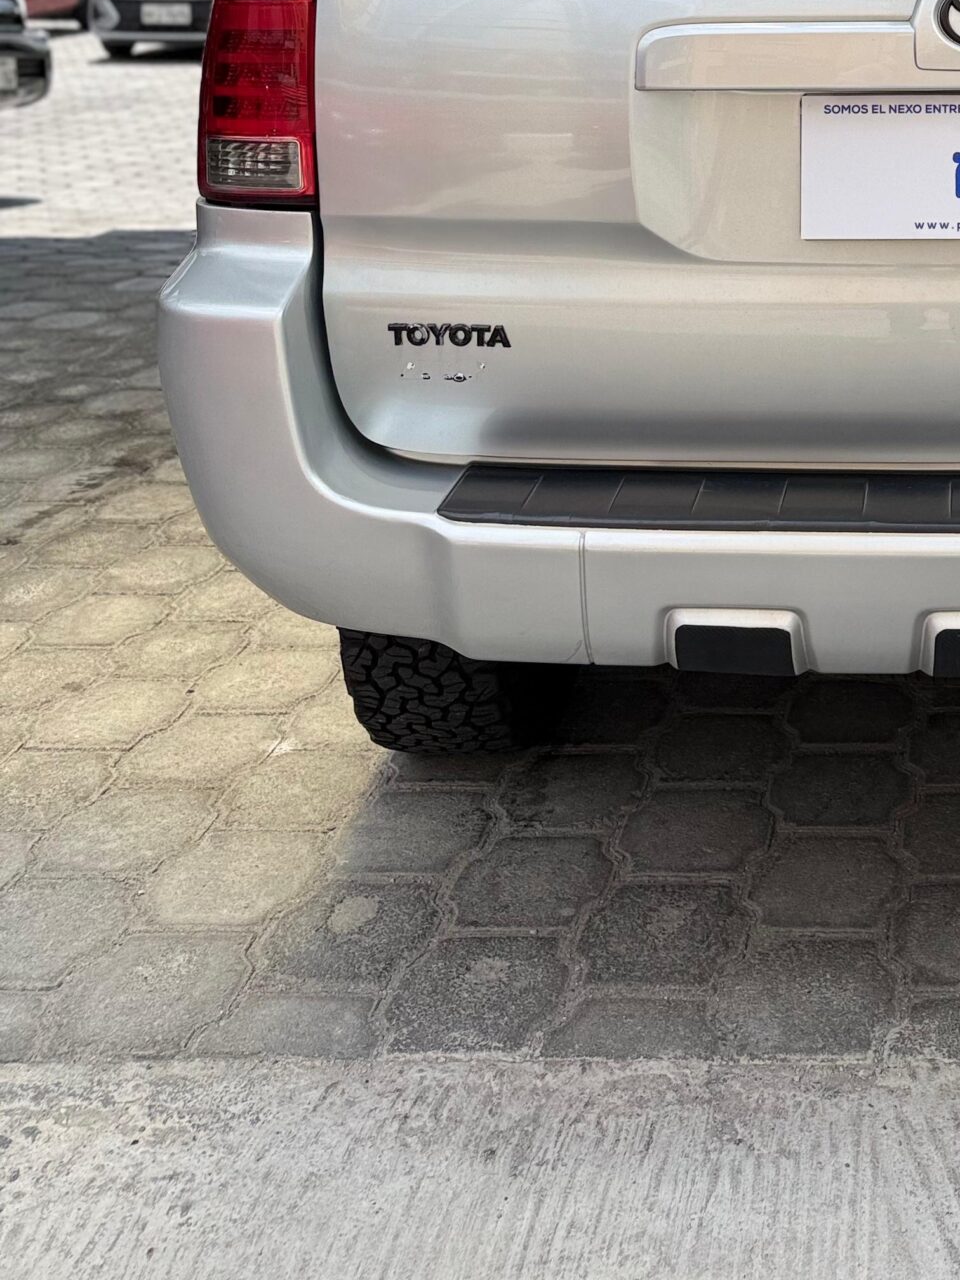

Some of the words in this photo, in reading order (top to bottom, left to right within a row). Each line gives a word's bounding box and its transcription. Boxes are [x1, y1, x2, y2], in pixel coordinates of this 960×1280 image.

[823, 104, 868, 115] SOMOS
[871, 104, 887, 115] EL
[888, 104, 922, 115] NEXO
[387, 322, 512, 348] TOYOTA
